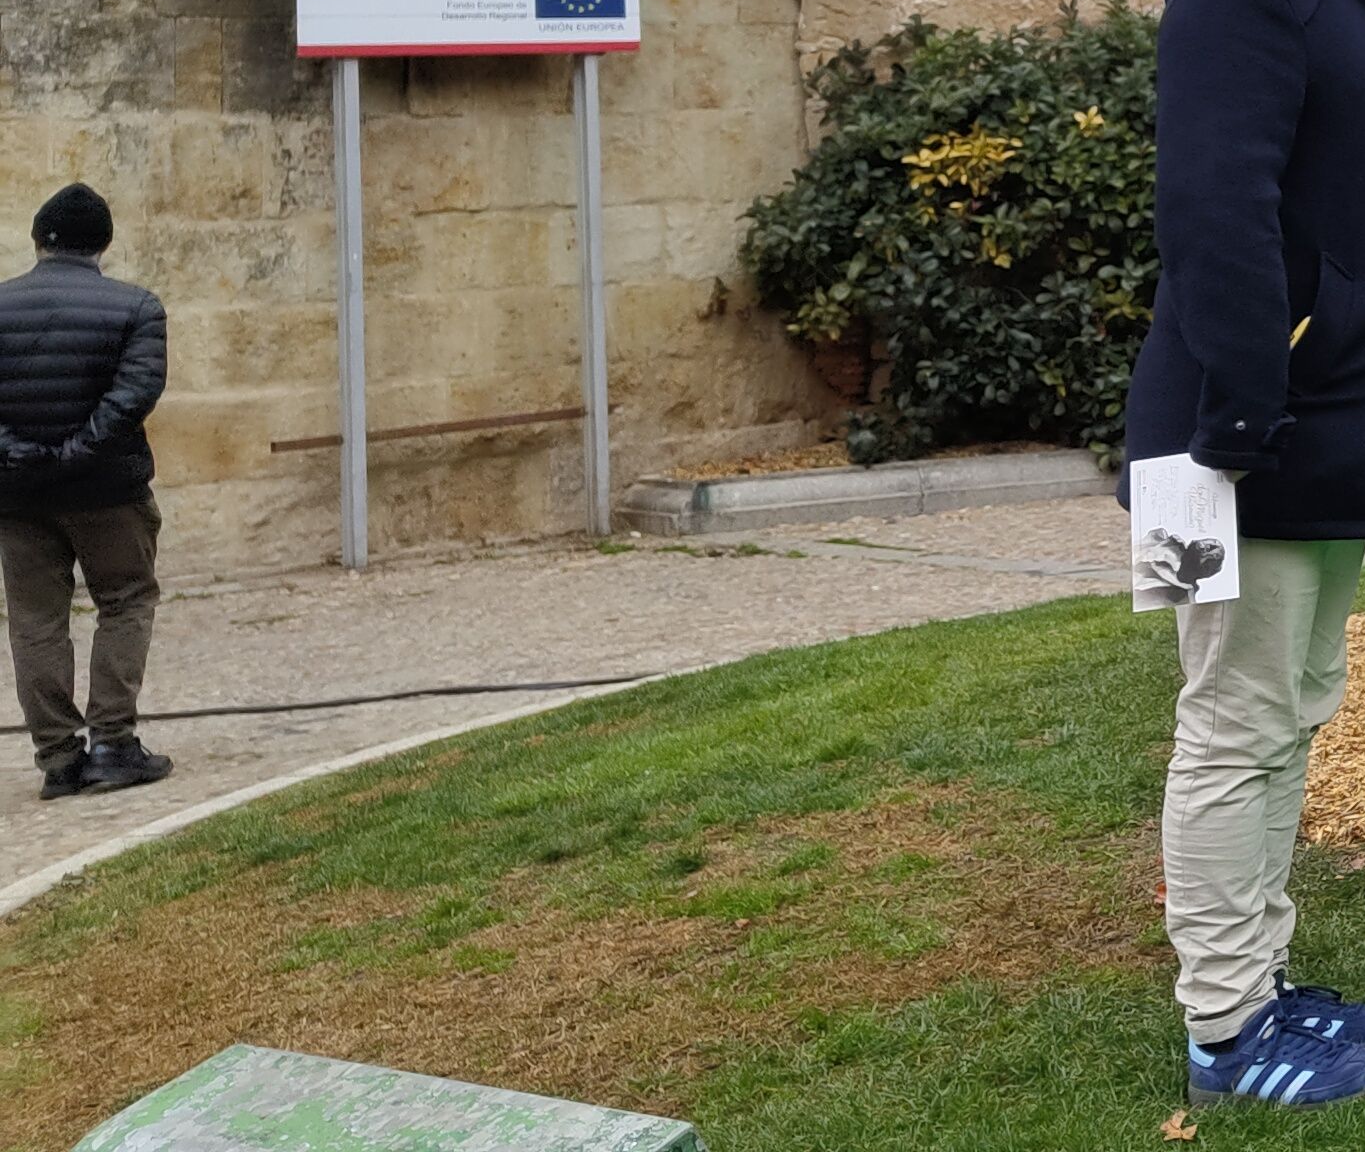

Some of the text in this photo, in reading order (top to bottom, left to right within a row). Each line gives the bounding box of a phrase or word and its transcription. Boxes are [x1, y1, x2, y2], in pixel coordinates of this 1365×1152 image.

[447, 1, 527, 11] Fondo Europeo de
[489, 12, 528, 22] Regional
[539, 22, 625, 33] UNIÓN EUROPEA
